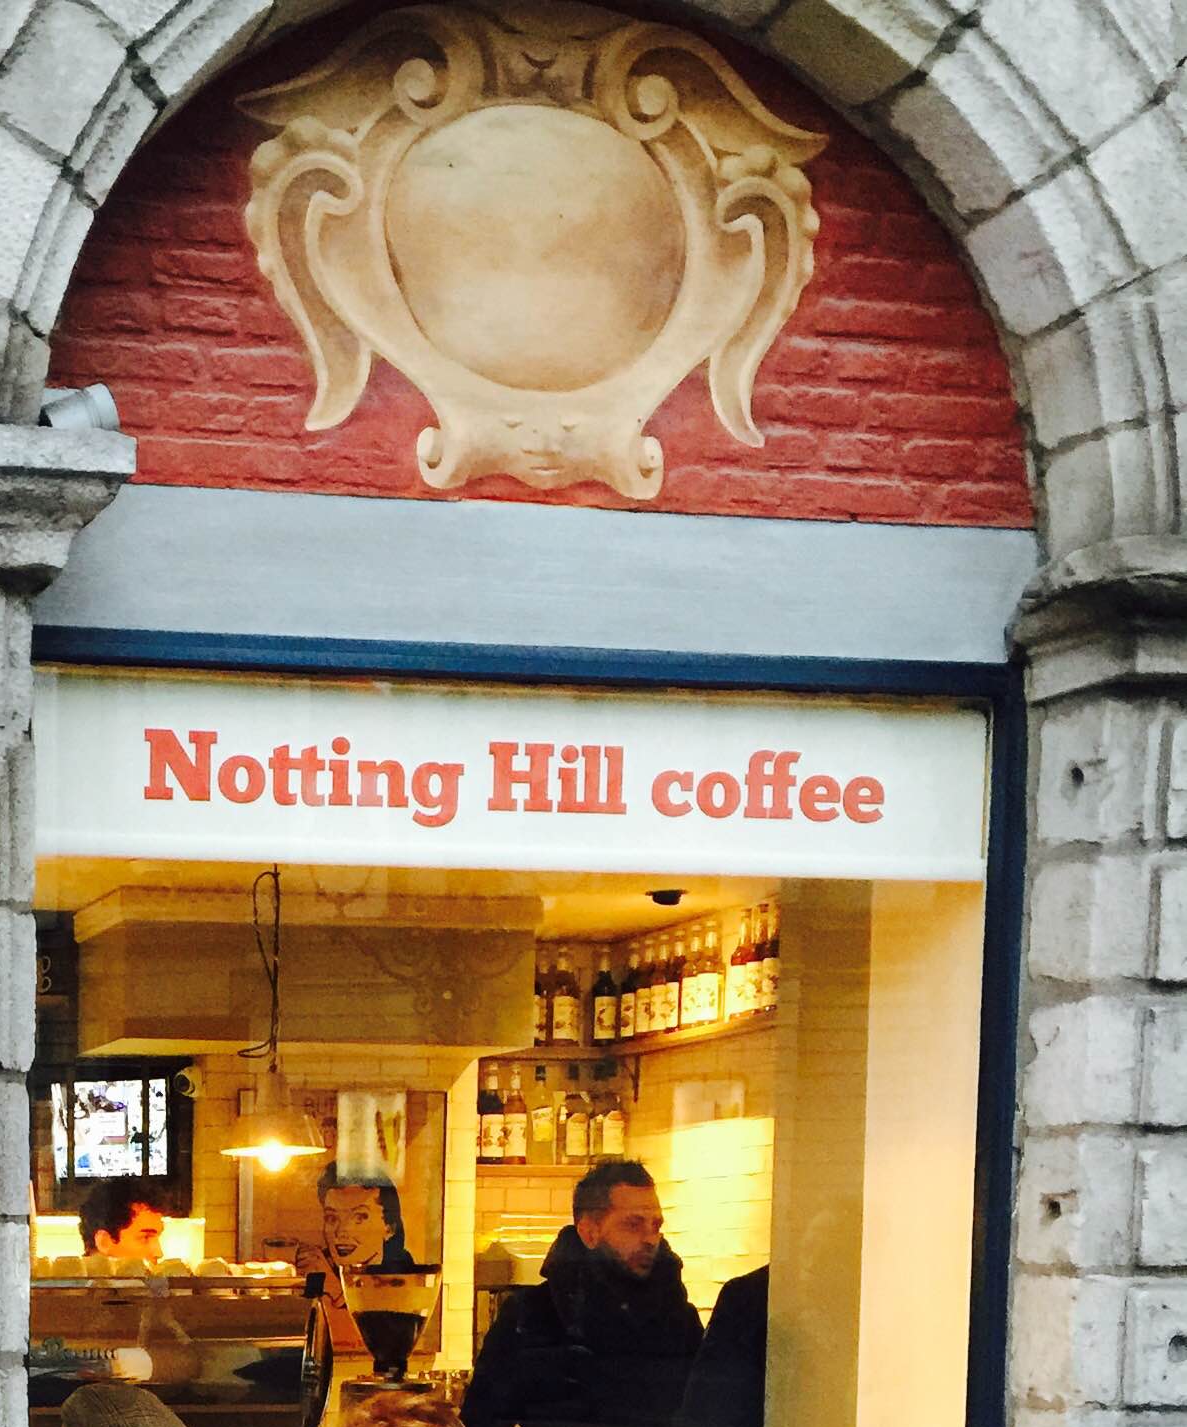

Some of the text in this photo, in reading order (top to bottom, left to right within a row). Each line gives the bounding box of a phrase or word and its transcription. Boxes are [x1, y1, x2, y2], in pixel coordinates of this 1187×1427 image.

[144, 728, 885, 828] Notting Hill coffee
